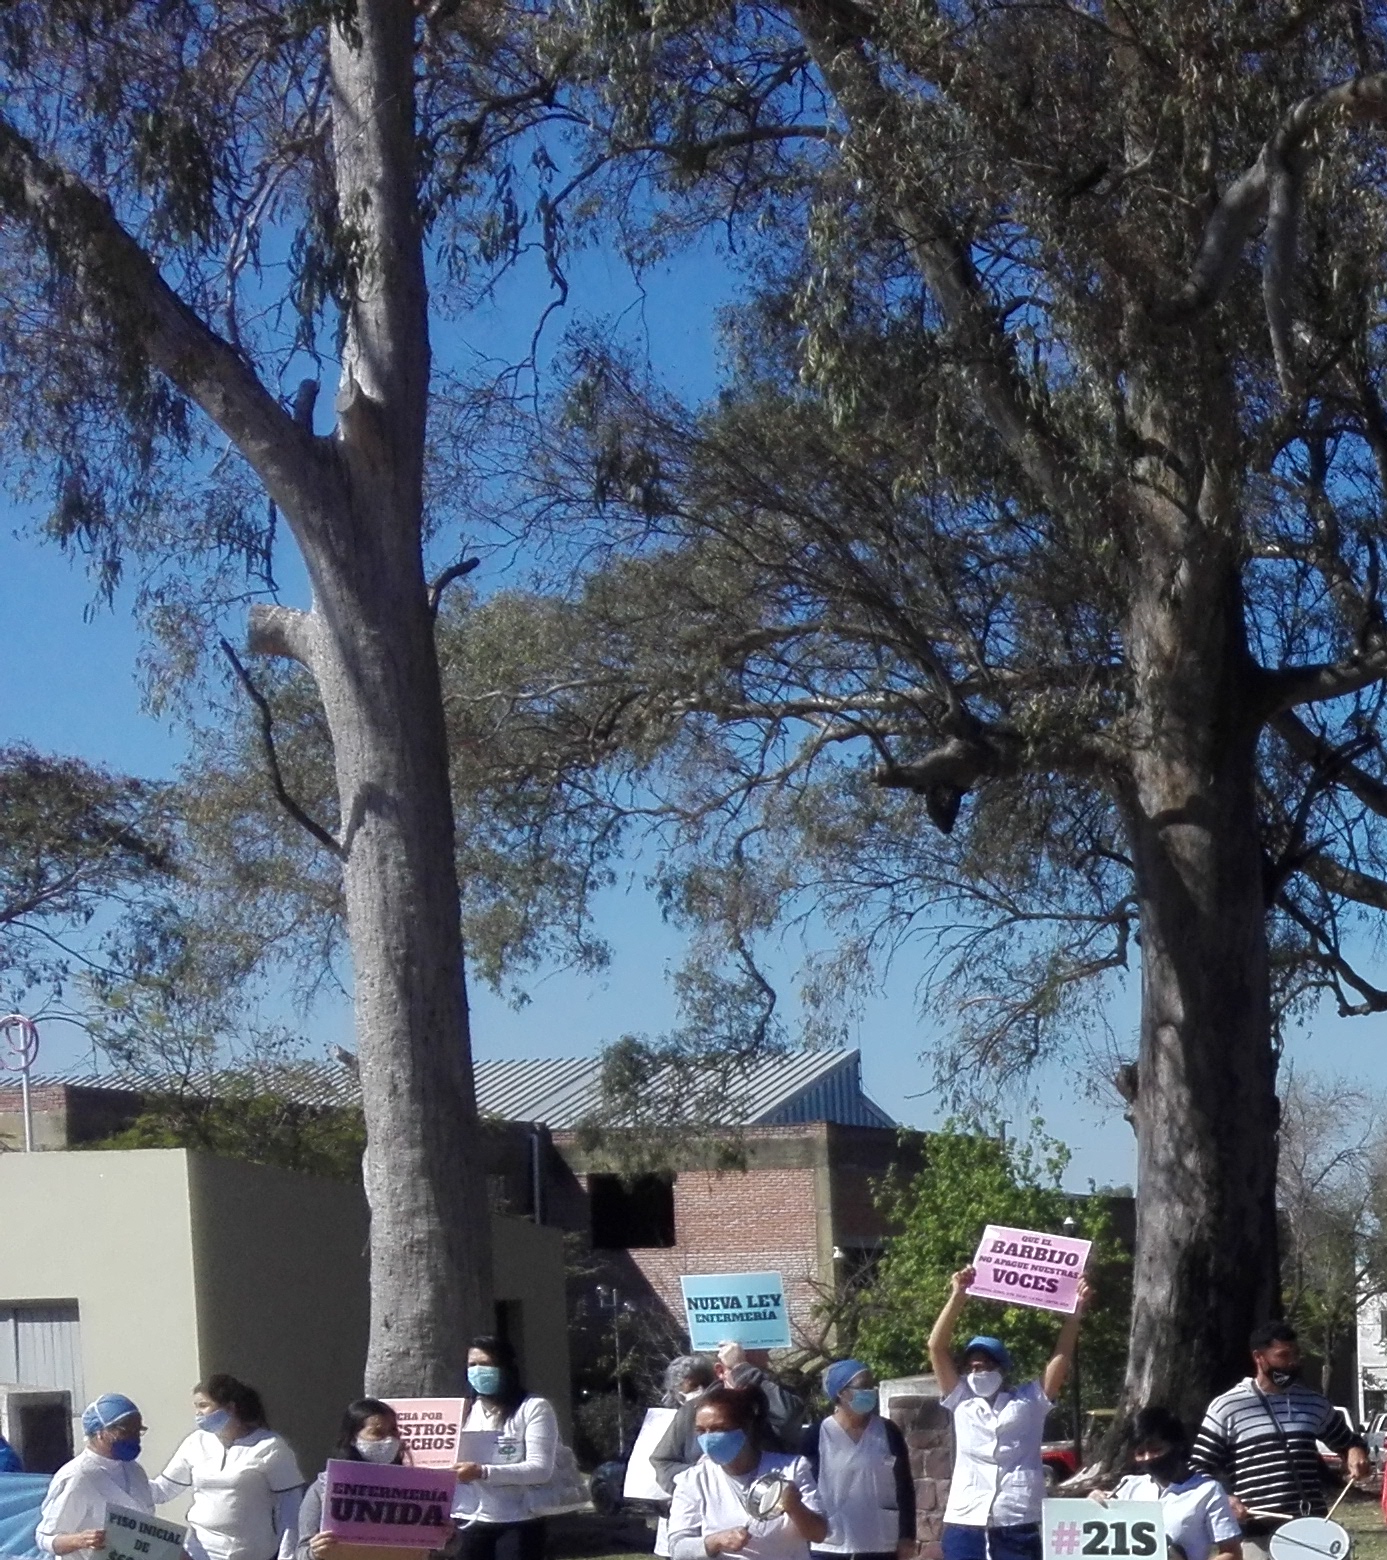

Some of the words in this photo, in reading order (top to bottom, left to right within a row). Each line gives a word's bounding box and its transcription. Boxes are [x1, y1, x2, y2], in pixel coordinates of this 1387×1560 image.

[1022, 1235, 1040, 1245] QUE
[1041, 1239, 1052, 1247] EL
[990, 1241, 1080, 1267] BARBIJO
[979, 1255, 993, 1263] NO
[994, 1257, 1029, 1270] APAGUE
[1030, 1264, 1080, 1279] NUESTRAS
[993, 1268, 1060, 1294] VOCES
[686, 1296, 743, 1310] NUEVA
[746, 1293, 782, 1309] LEY
[695, 1309, 777, 1323] ENFERMERÍA
[396, 1412, 418, 1421] CHA
[402, 1437, 456, 1450] ECHOS
[330, 1497, 444, 1527] UNIDA
[109, 1512, 137, 1530] PISO
[139, 1522, 181, 1545] INICIAL
[1051, 1521, 1158, 1556] #21S
[134, 1539, 151, 1553] DE
